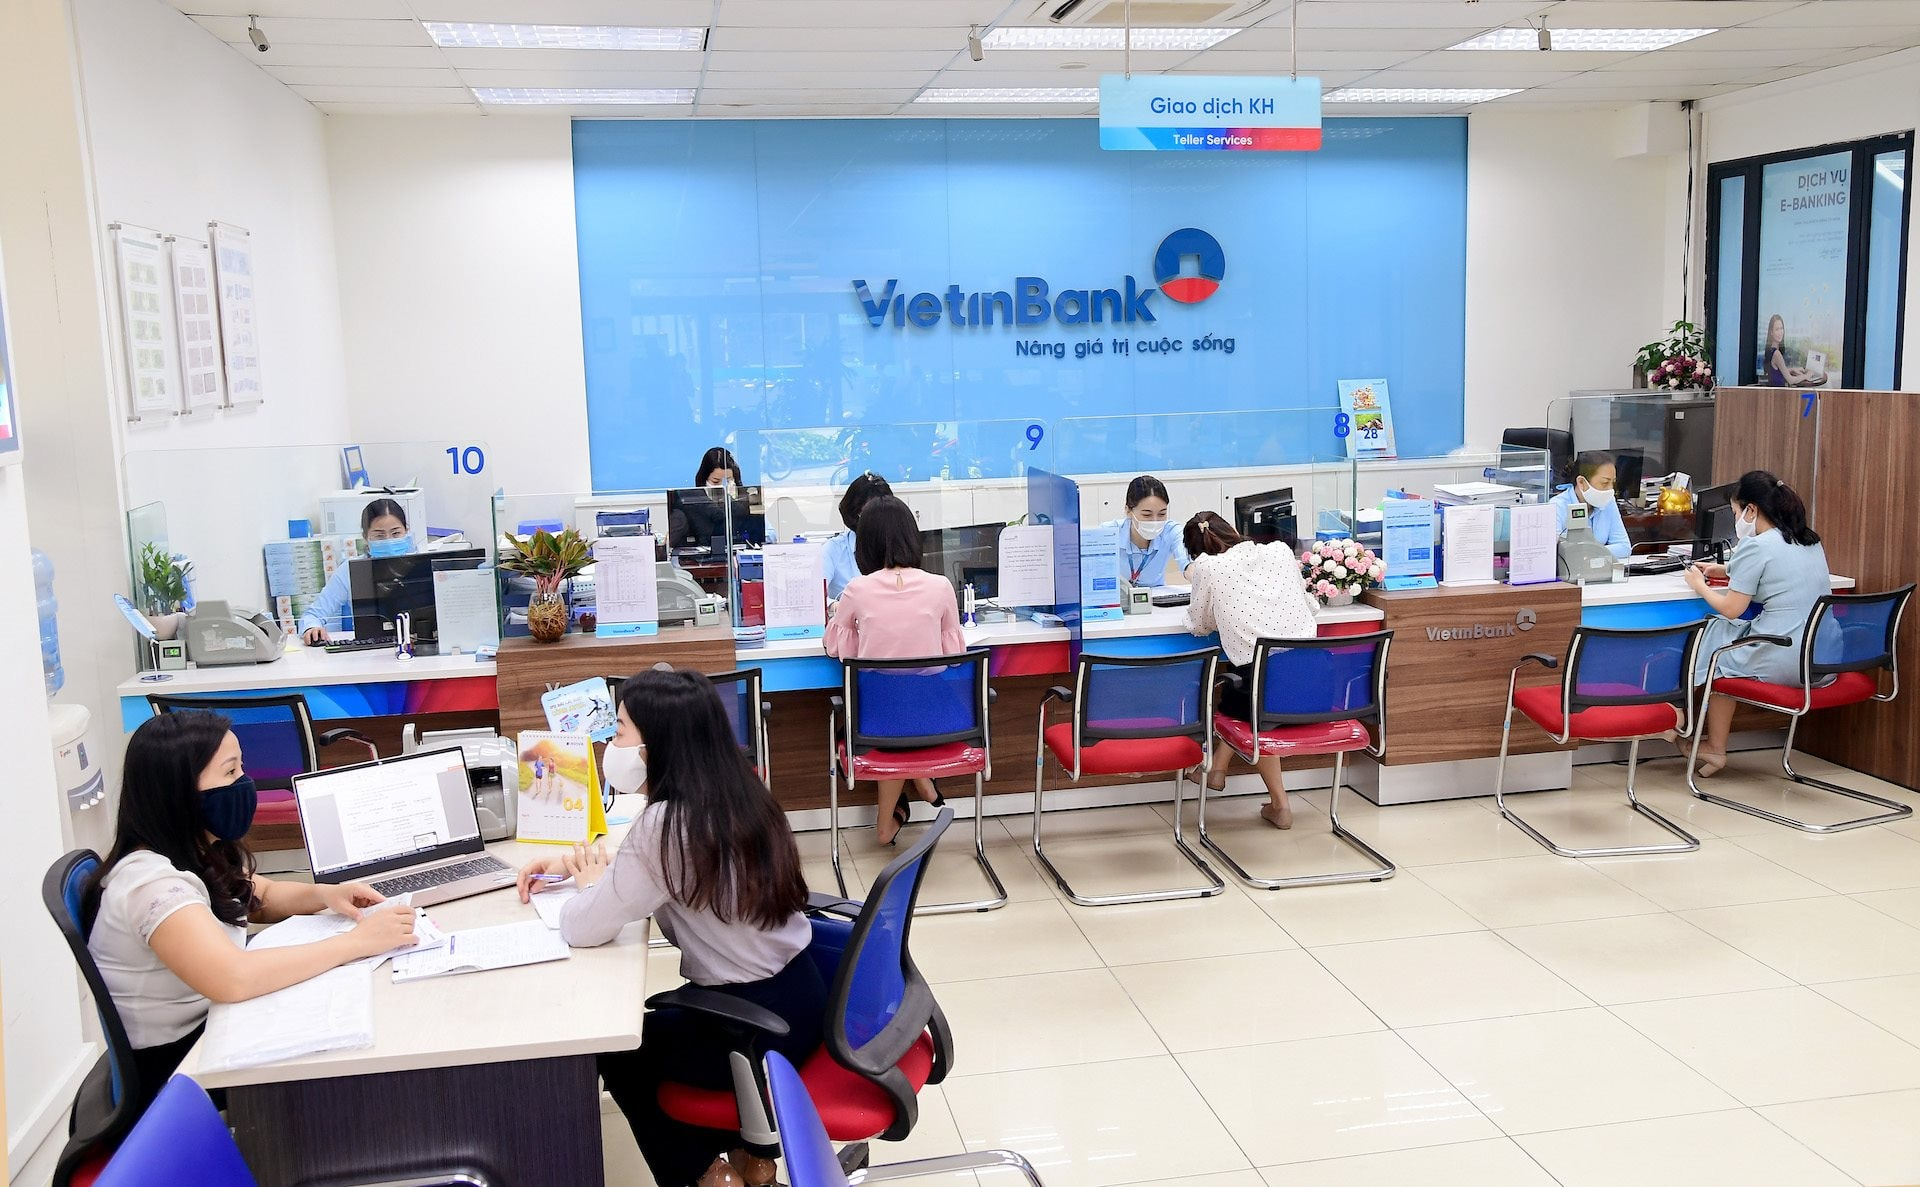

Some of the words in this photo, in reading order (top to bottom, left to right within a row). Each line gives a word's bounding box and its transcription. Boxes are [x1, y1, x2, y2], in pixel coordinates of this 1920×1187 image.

[1150, 97, 1197, 114] Giao
[1203, 97, 1243, 119] dịch
[1250, 97, 1275, 115] KH
[1173, 134, 1204, 145] Teller
[1206, 134, 1253, 145] Services
[1798, 172, 1827, 191] DỊCH
[1830, 169, 1847, 187] VỤ
[1780, 191, 1846, 212] E-BANKING
[852, 274, 1156, 328] VietinBank
[1016, 339, 1066, 359] Nâng
[1075, 337, 1104, 359] giá
[1112, 338, 1129, 357] trị
[1136, 336, 1183, 356] cuộc
[1192, 332, 1236, 355] sống
[1801, 393, 1817, 417] 7
[1333, 412, 1351, 438] 8
[1363, 428, 1379, 440] 28
[1025, 425, 1044, 451] 9
[446, 447, 486, 475] 10
[1425, 622, 1516, 642] VietinBank
[563, 797, 584, 812] 04
